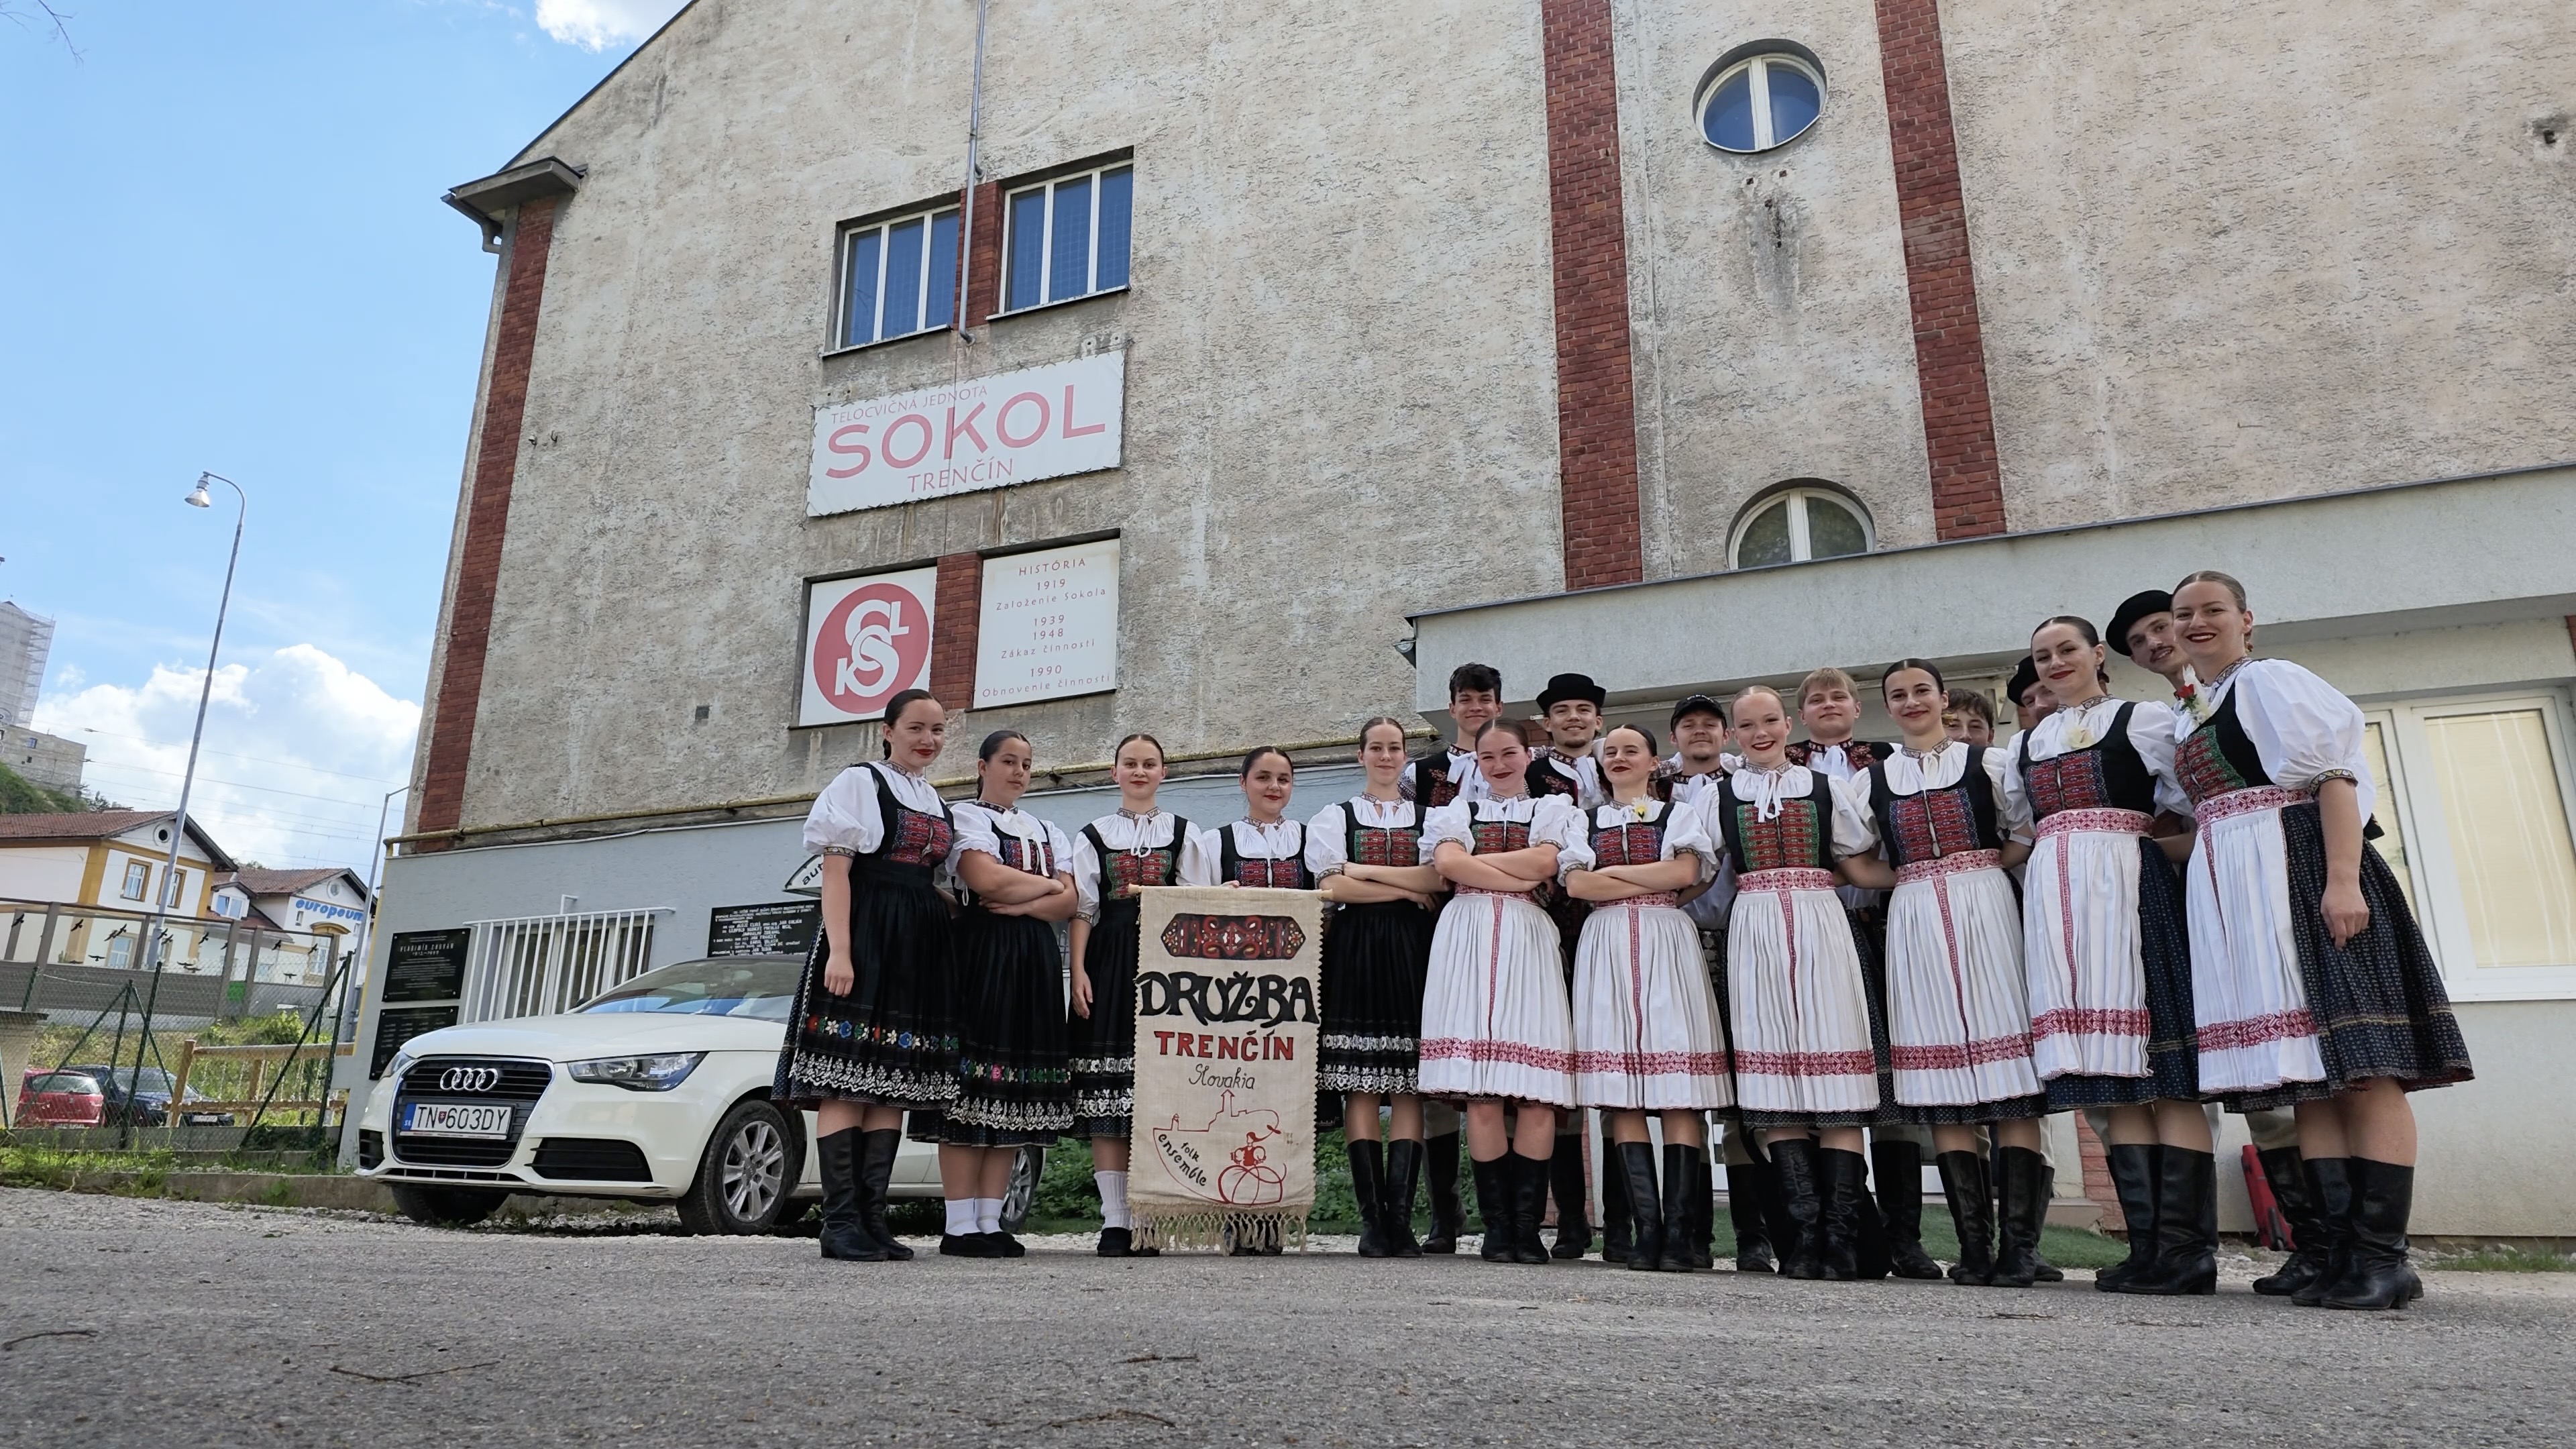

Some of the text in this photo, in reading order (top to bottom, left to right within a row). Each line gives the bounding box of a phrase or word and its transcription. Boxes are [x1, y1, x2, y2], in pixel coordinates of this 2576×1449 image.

[831, 385, 987, 424] TELOCVIČNÁ JEDNOTA
[825, 384, 1106, 479] SOKOL
[908, 456, 1014, 492] TRENČÍN
[1018, 558, 1085, 576] HISTÓRIA
[1037, 578, 1066, 591] 1919
[996, 588, 1106, 610] Založenie Sokola
[1034, 614, 1065, 627] 1939
[1033, 628, 1063, 641] 1948
[1001, 639, 1095, 659] Zákaz činnosti
[1030, 665, 1062, 678] 1990
[982, 674, 1110, 698] Obnovenie činnosti
[1134, 971, 1320, 1028] DRUŽBA
[1188, 1063, 1256, 1090] Slovakia
[1158, 1133, 1207, 1187] ensemble
[1181, 1142, 1200, 1163] folk
